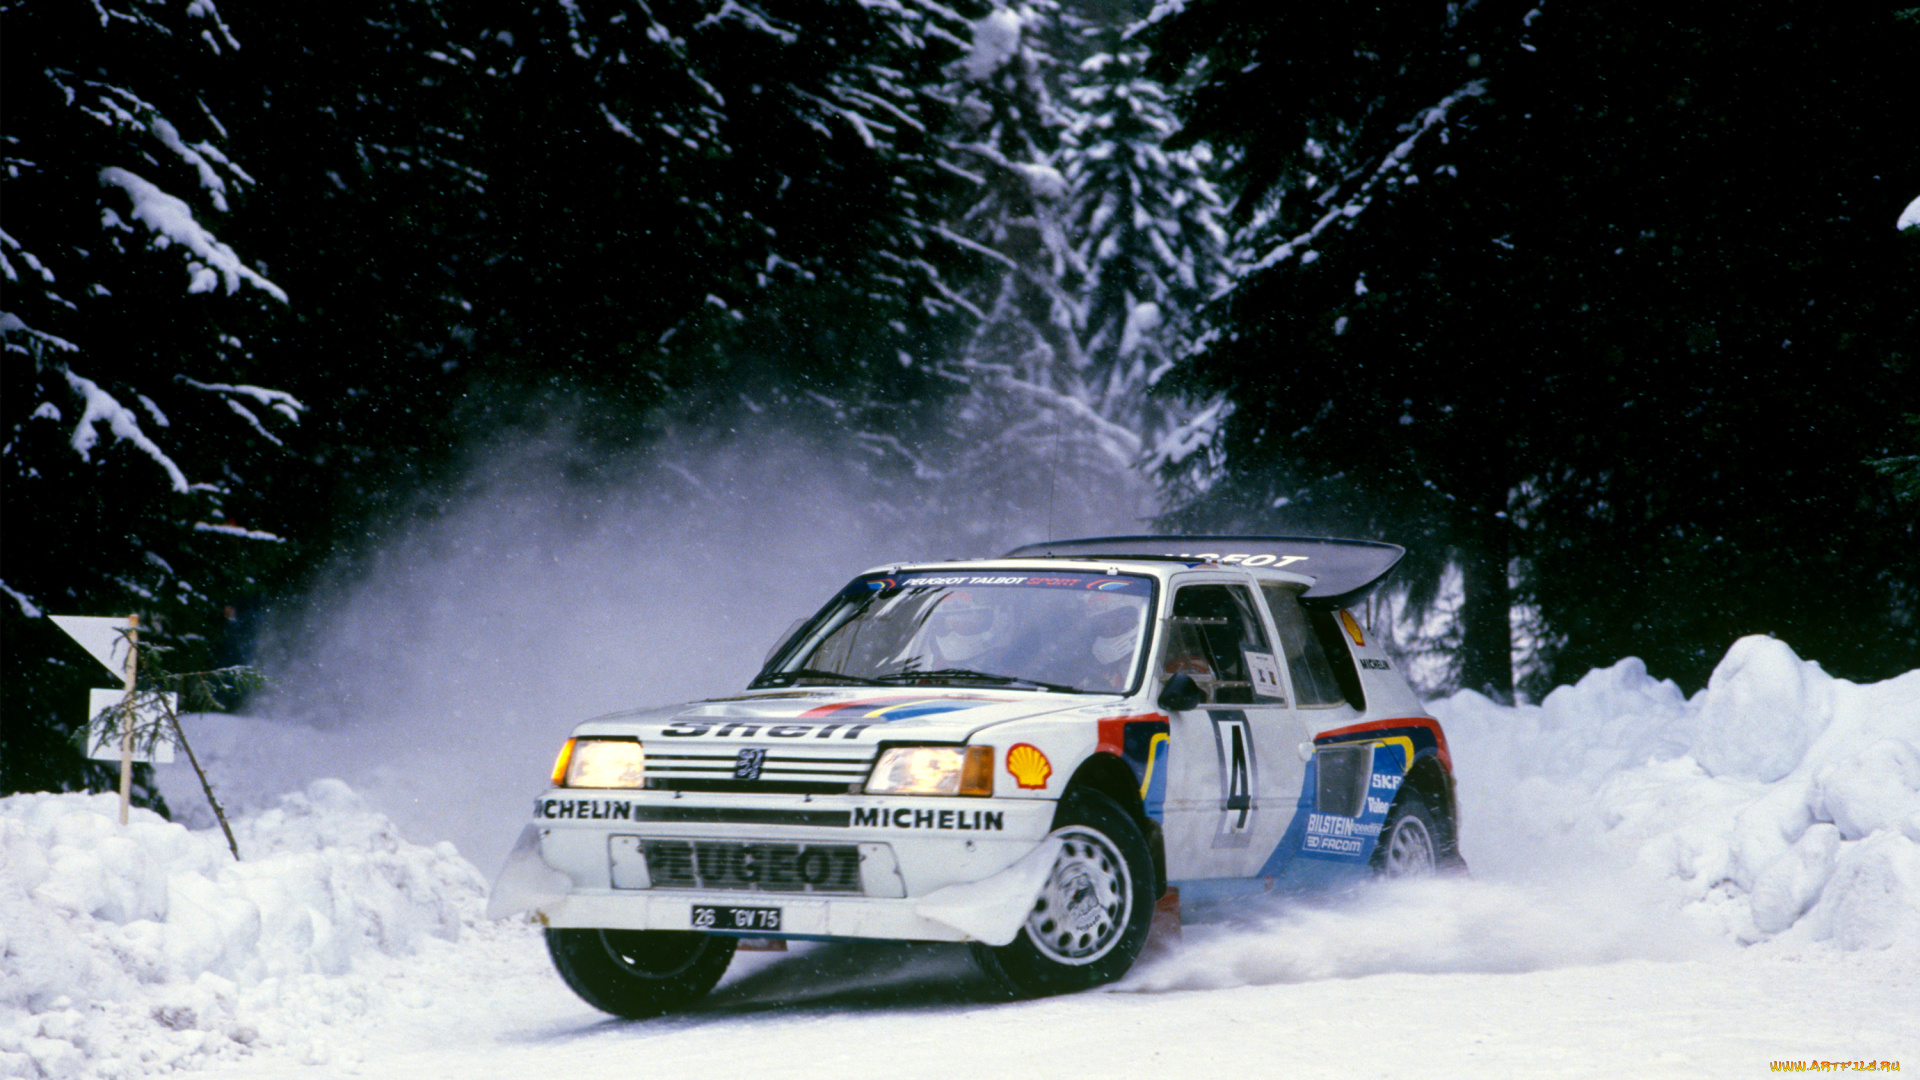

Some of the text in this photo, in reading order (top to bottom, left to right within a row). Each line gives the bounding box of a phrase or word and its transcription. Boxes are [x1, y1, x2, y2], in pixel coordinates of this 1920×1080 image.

[901, 577, 1081, 587] PEUGEOT TALBOT SPORT
[1360, 658, 1391, 670] MICHELIN
[1227, 725, 1251, 828] 4
[1372, 773, 1402, 790] SKF
[1367, 796, 1390, 814] Valeo
[854, 807, 1004, 831] MICHELIN
[1307, 813, 1354, 836] BILSTEIN
[1321, 837, 1361, 852] FACOM
[694, 908, 779, 928] 26 GV 75
